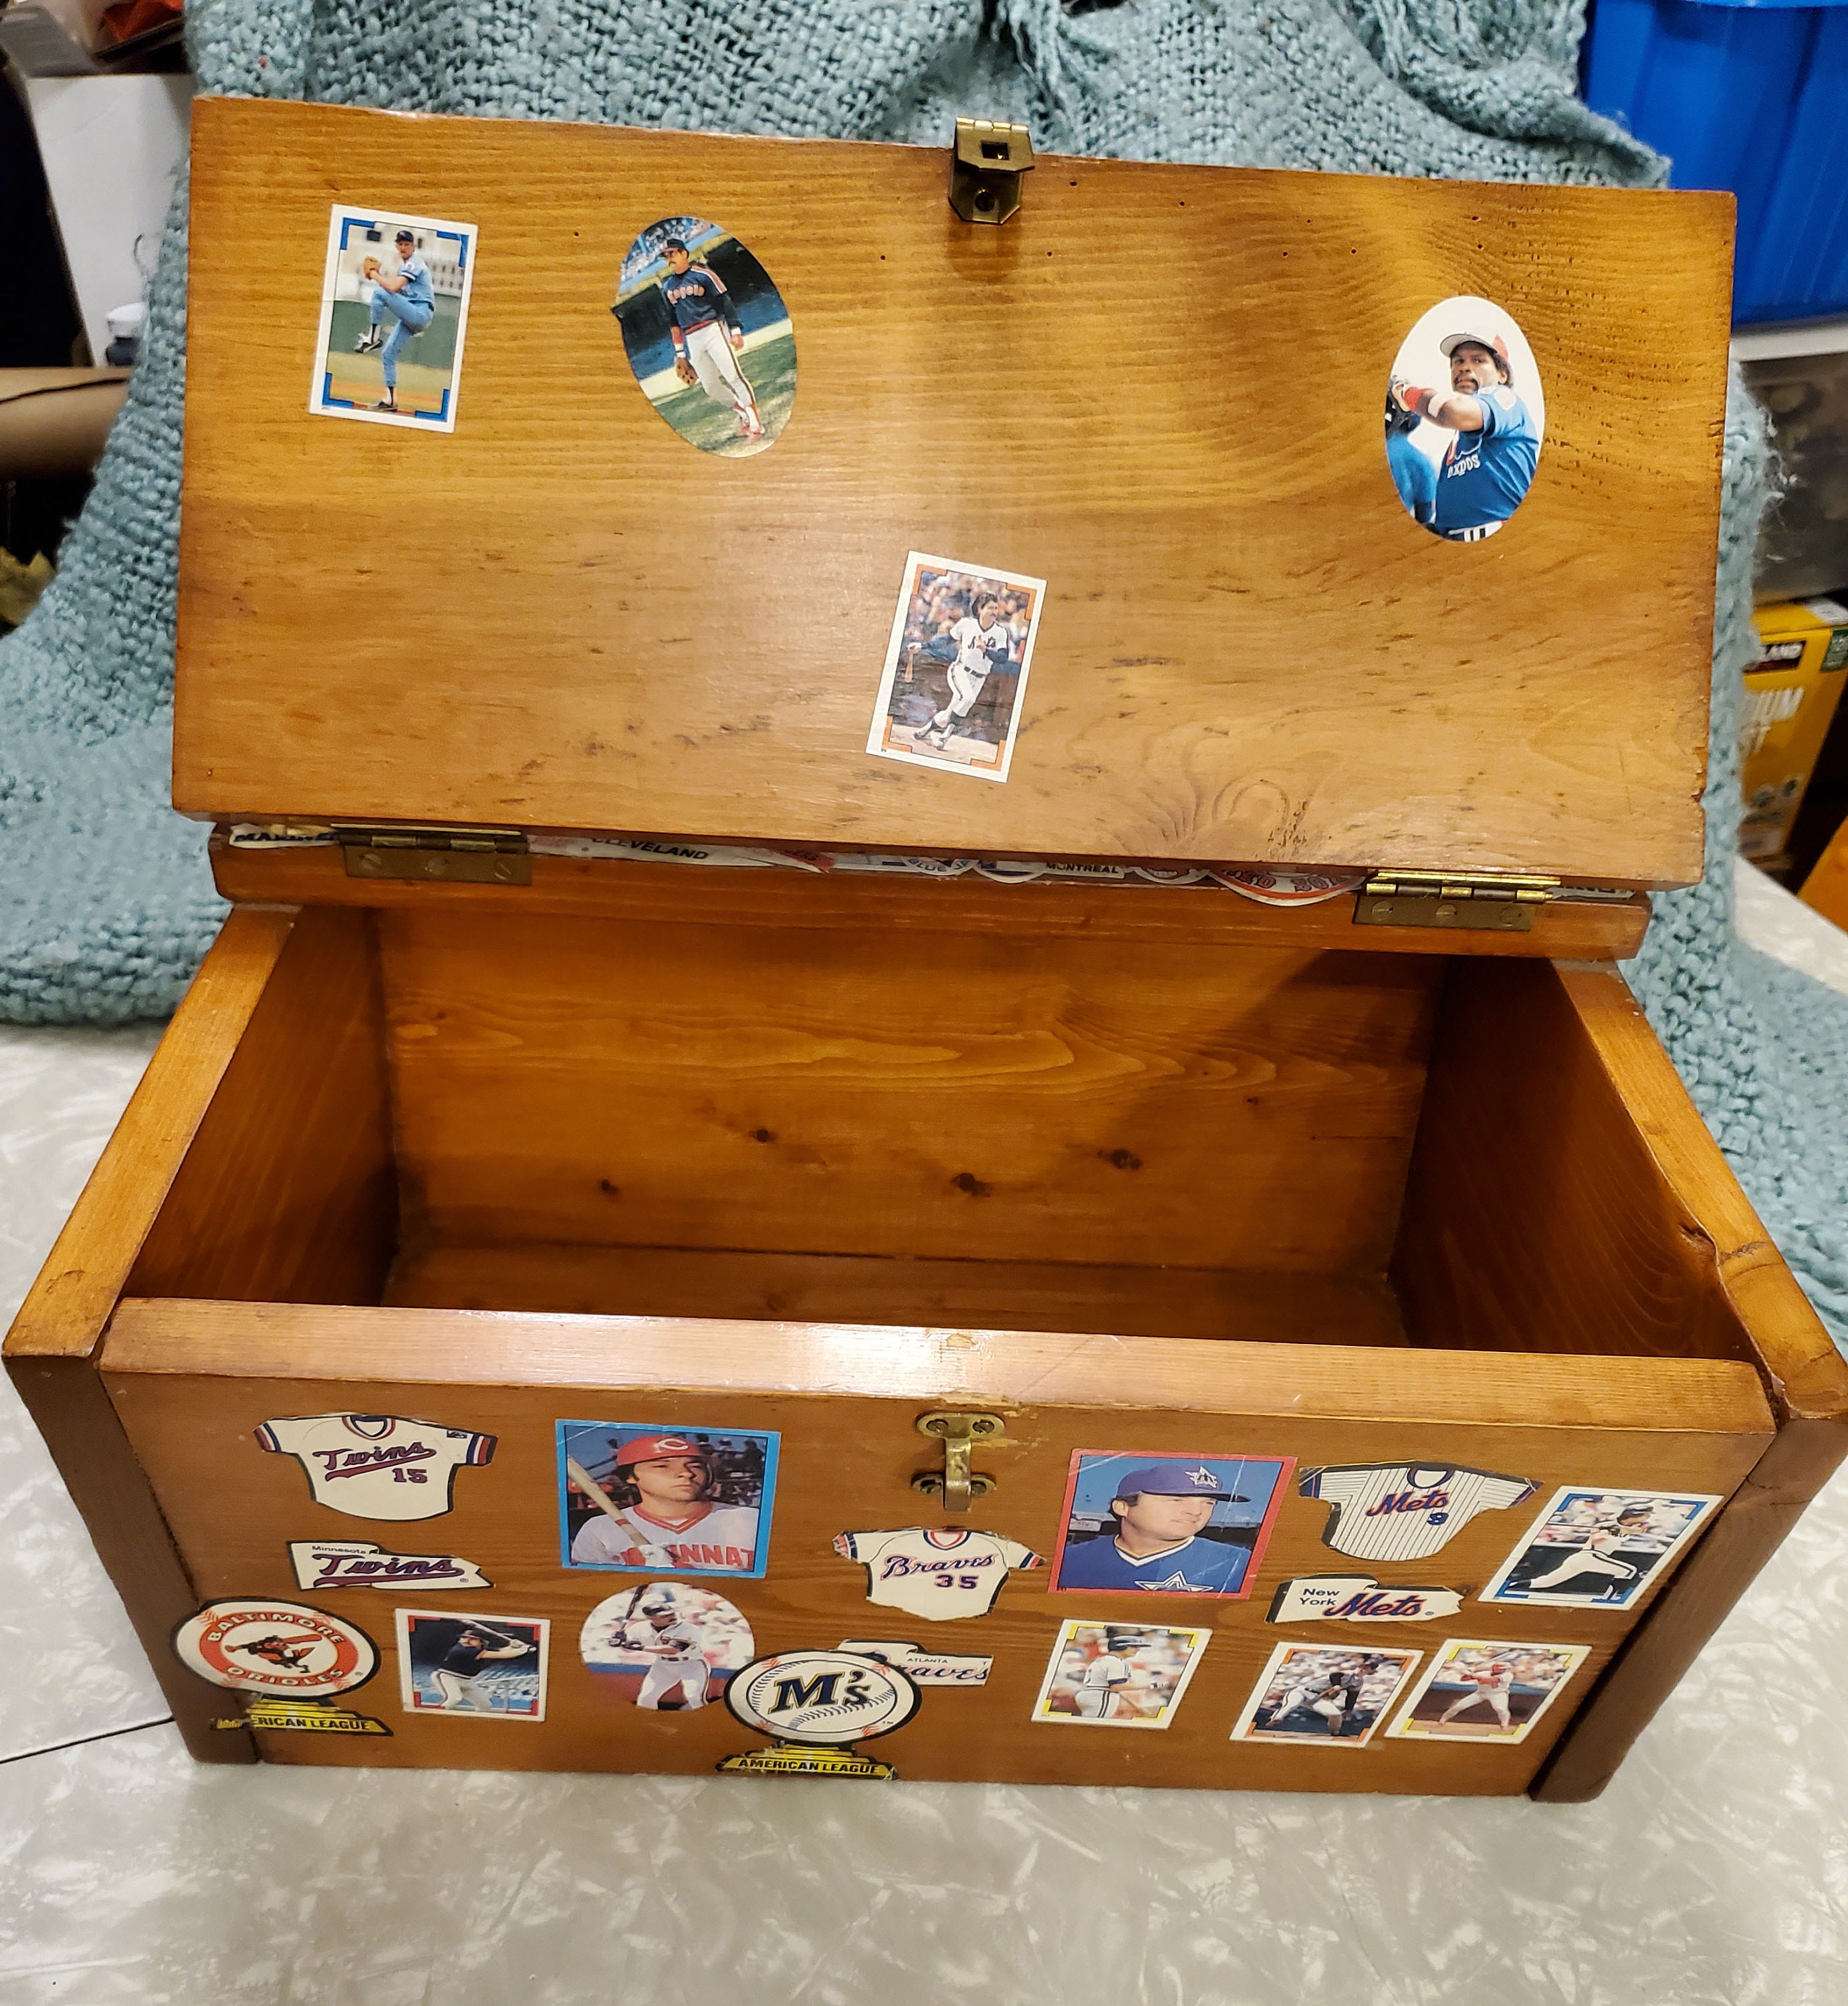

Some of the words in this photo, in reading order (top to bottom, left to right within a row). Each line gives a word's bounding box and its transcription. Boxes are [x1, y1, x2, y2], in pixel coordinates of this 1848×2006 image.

[1046, 863, 1119, 874] MONTREAL
[312, 1442, 437, 1482] Twins
[391, 1468, 428, 1484] 15
[1365, 1490, 1450, 1518] Mets
[312, 1545, 367, 1555] Minnesota
[312, 1553, 465, 1587] Twins
[880, 1553, 1000, 1581] Braves
[934, 1574, 979, 1590] 35
[1303, 1588, 1341, 1597] New
[1300, 1597, 1337, 1606] York
[1323, 1593, 1428, 1617] Mets
[207, 1613, 345, 1644] BALTIMORE
[227, 1667, 344, 1686] ORIOLES
[767, 1670, 873, 1714] M's
[310, 1717, 370, 1730] LEAGUE
[738, 1758, 820, 1772] AMERICAN
[822, 1762, 880, 1775] LEAGUE
